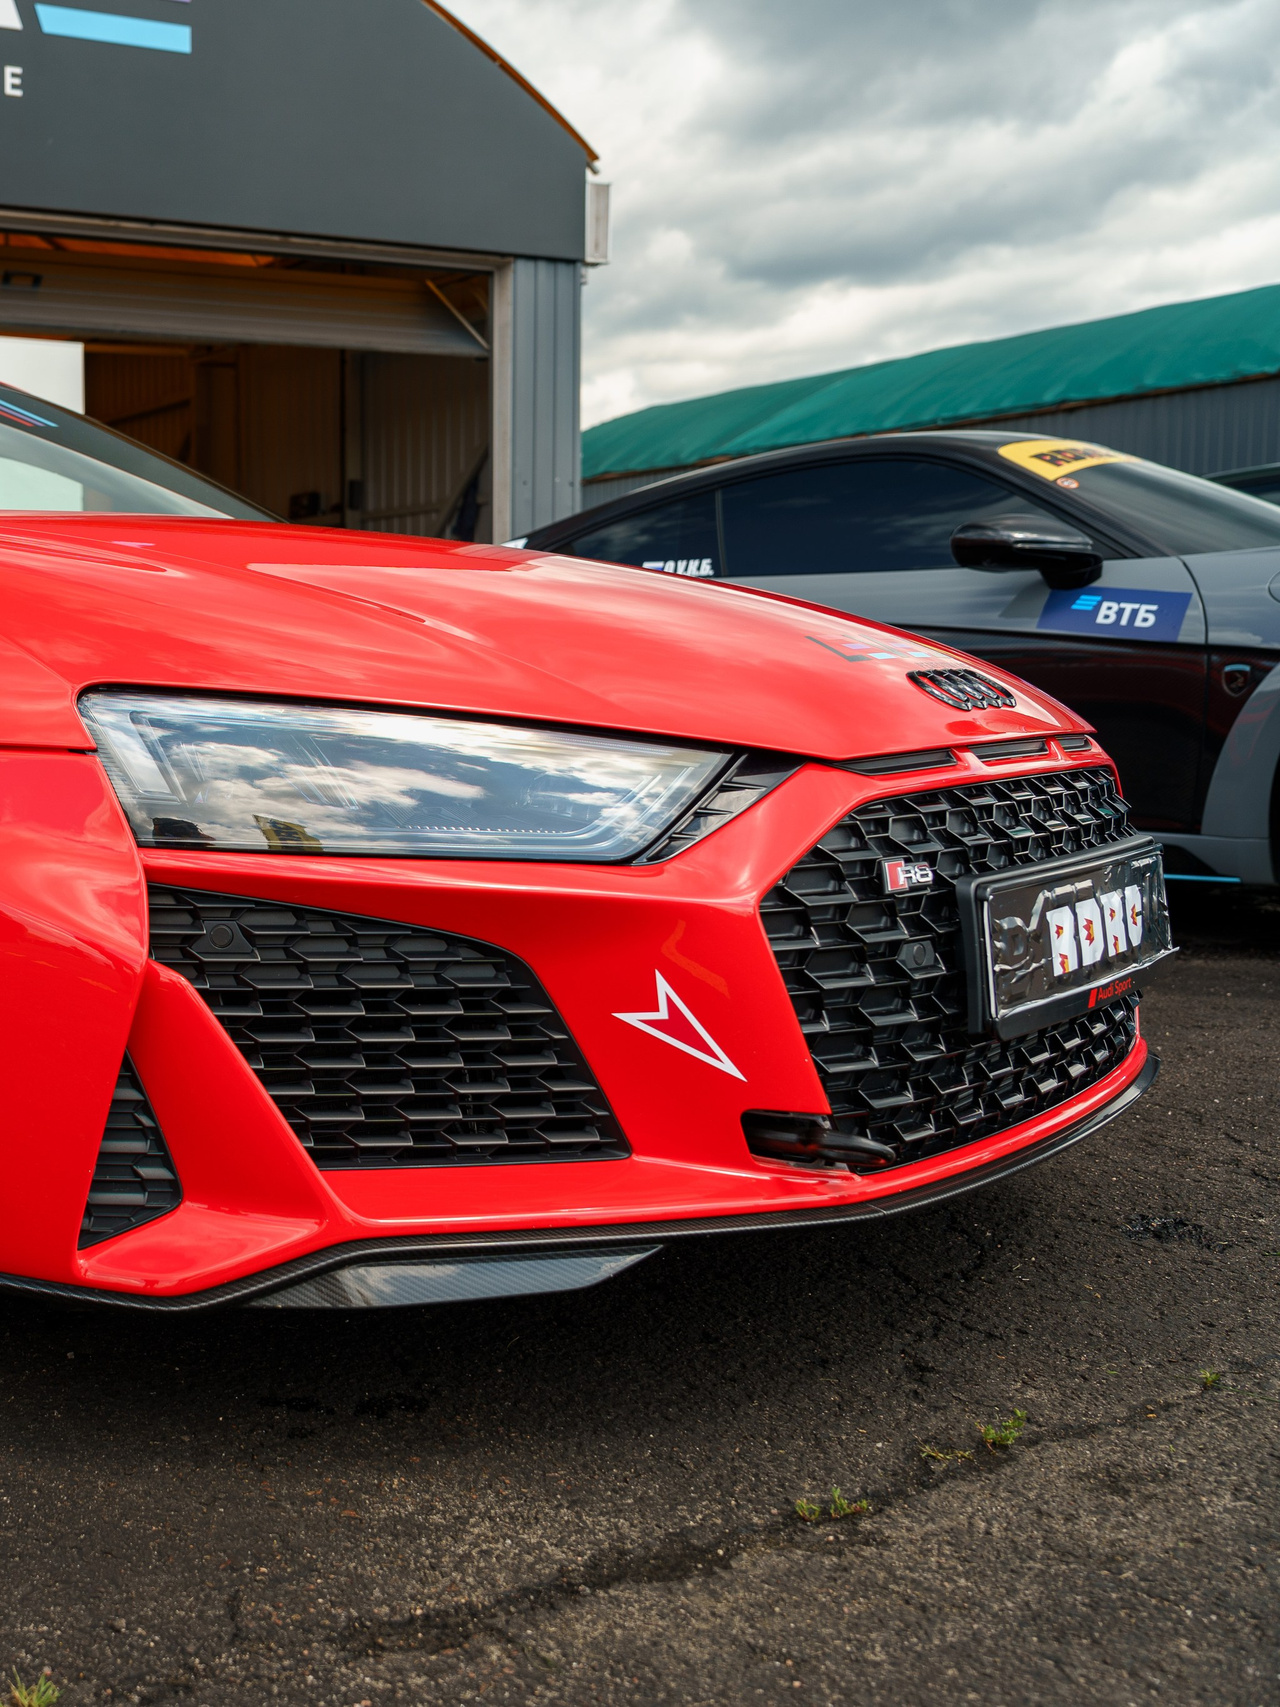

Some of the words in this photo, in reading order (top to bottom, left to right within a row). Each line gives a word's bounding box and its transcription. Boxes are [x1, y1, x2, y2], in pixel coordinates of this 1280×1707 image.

[1095, 600, 1159, 628] ВТБ
[896, 863, 934, 886] R8
[1045, 884, 1143, 977] RDRC
[1097, 982, 1114, 1001] Audi
[1114, 977, 1132, 996] Sport
